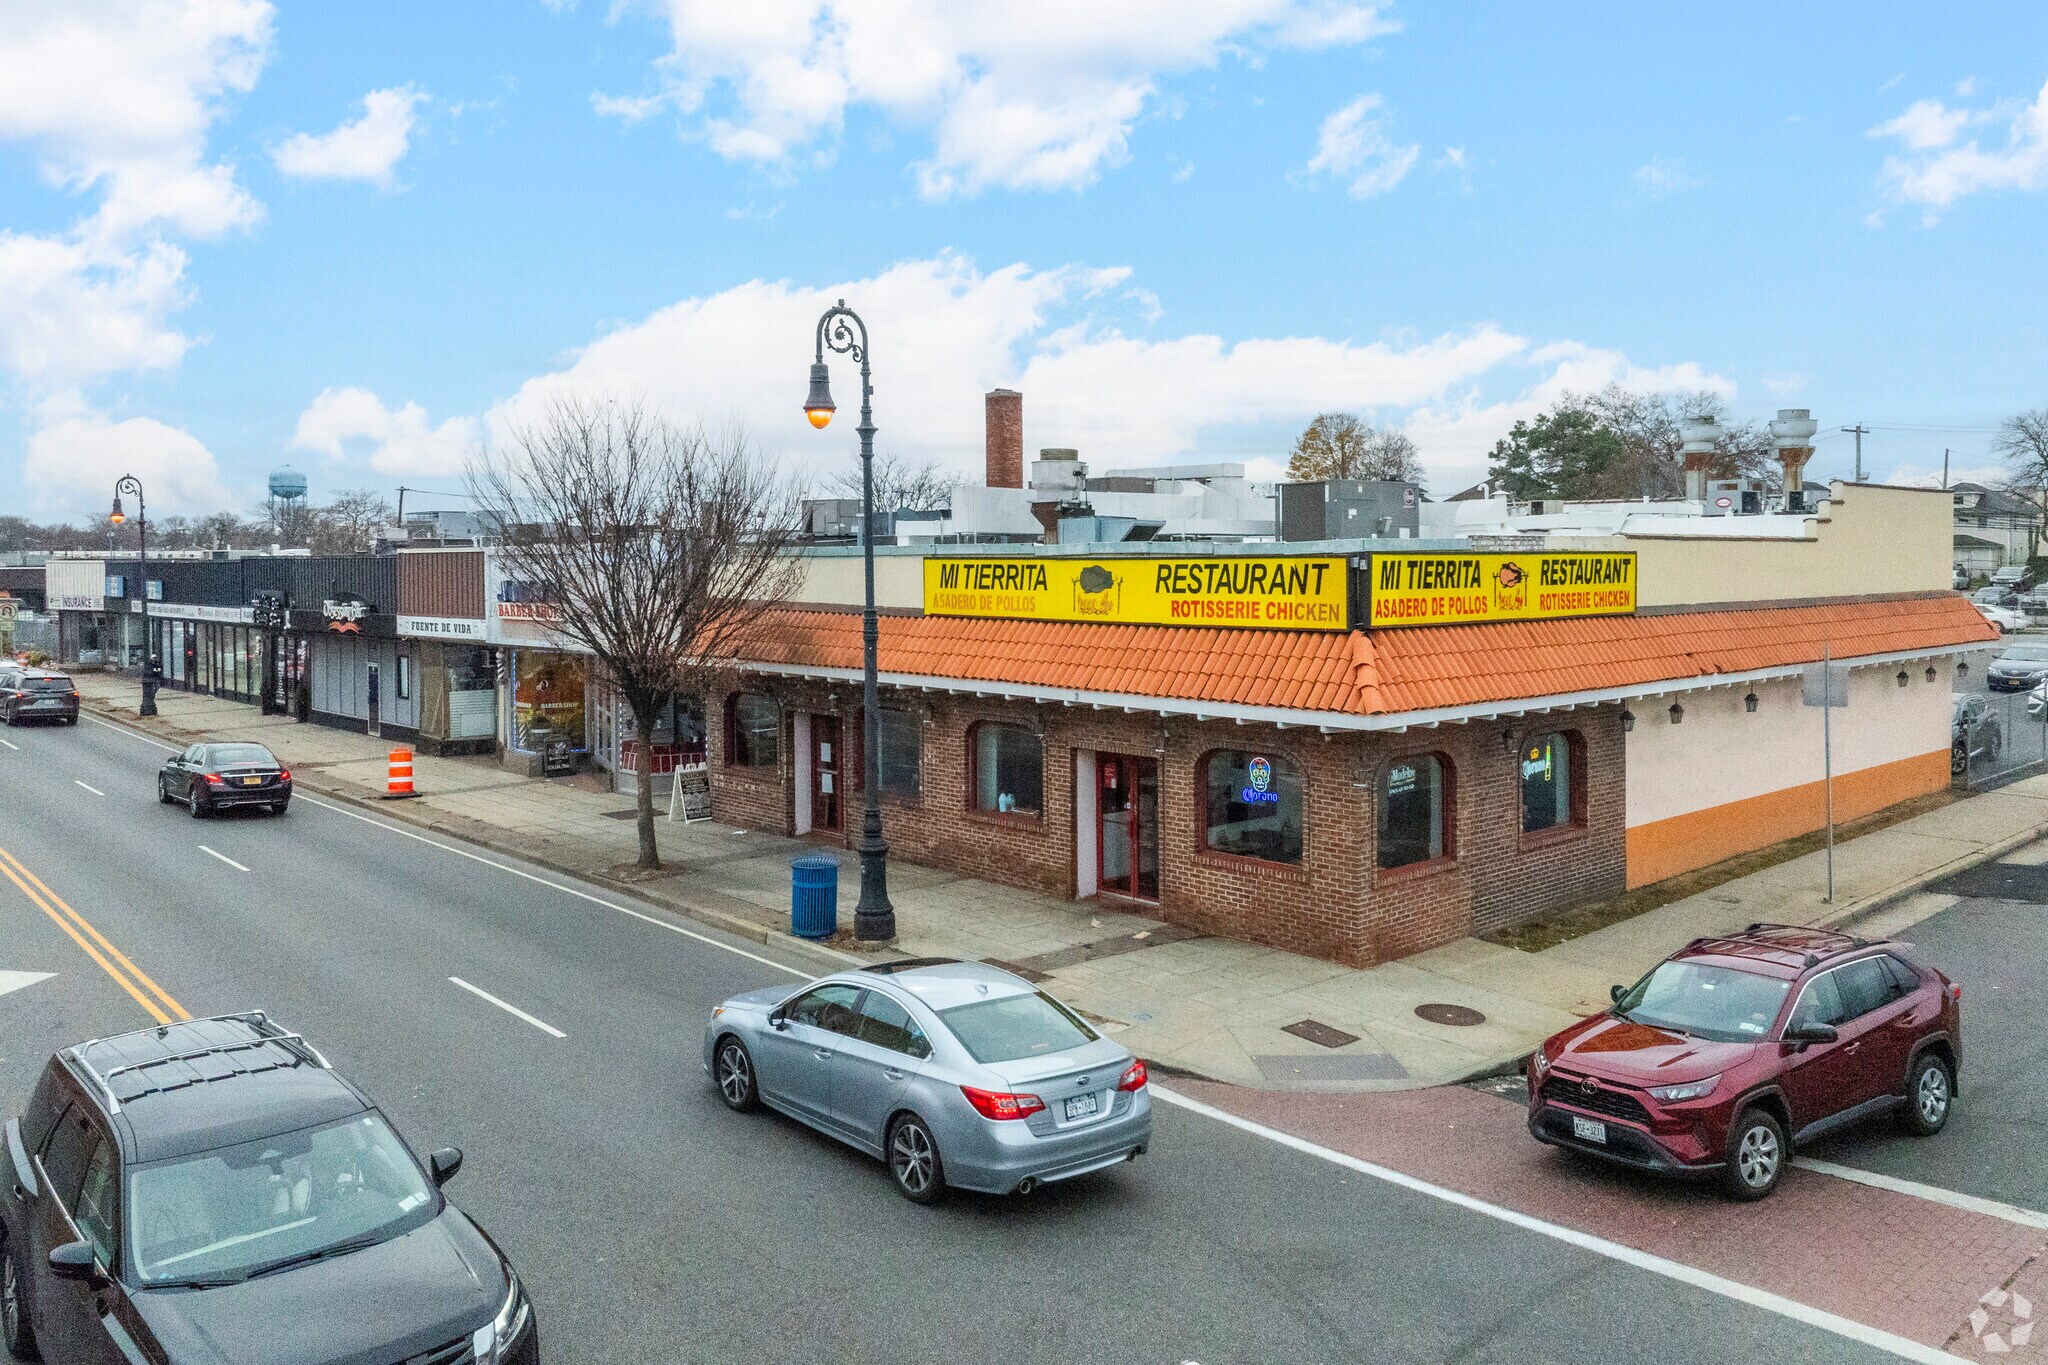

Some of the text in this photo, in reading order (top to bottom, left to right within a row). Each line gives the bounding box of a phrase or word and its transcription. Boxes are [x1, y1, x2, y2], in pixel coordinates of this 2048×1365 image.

[939, 563, 1048, 591] MI TIERRITA
[1155, 563, 1330, 595] RESTAURANT
[1380, 559, 1481, 590] MI TIERRITA
[1540, 558, 1631, 586] RESTAURANT
[62, 596, 91, 608] INSURANCE
[498, 603, 533, 617] BARBER
[932, 593, 1036, 612] ASADERO DE POLLOS
[1171, 599, 1340, 622] ROTISSERIE CHICKEN
[1375, 595, 1488, 618] ASADERO DE POLLOS
[1539, 590, 1630, 611] ROTISSERIE CHICKEN
[411, 621, 471, 634] FUENTE DE VIDA
[1242, 788, 1278, 802] Corona
